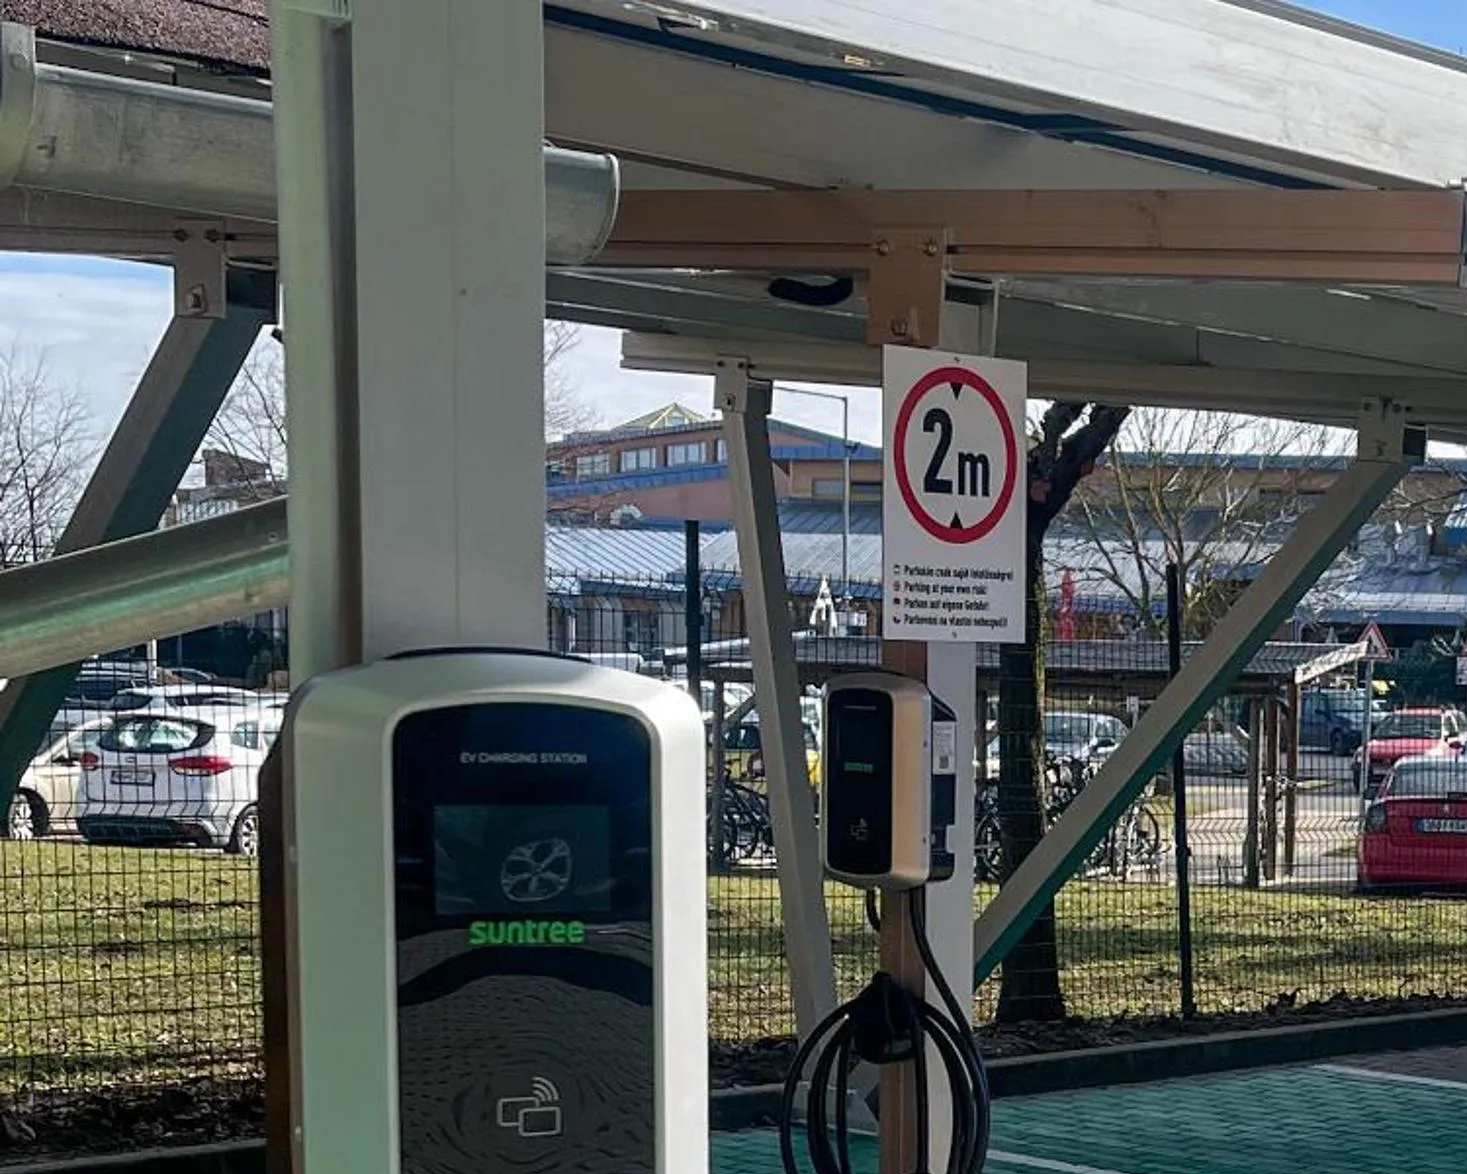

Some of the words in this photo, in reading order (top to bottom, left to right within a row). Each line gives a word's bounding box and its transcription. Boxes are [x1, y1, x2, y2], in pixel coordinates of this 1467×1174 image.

[922, 407, 991, 498] 2m
[459, 751, 477, 764] EV
[539, 752, 588, 764] STATION
[468, 919, 585, 944] suntree
